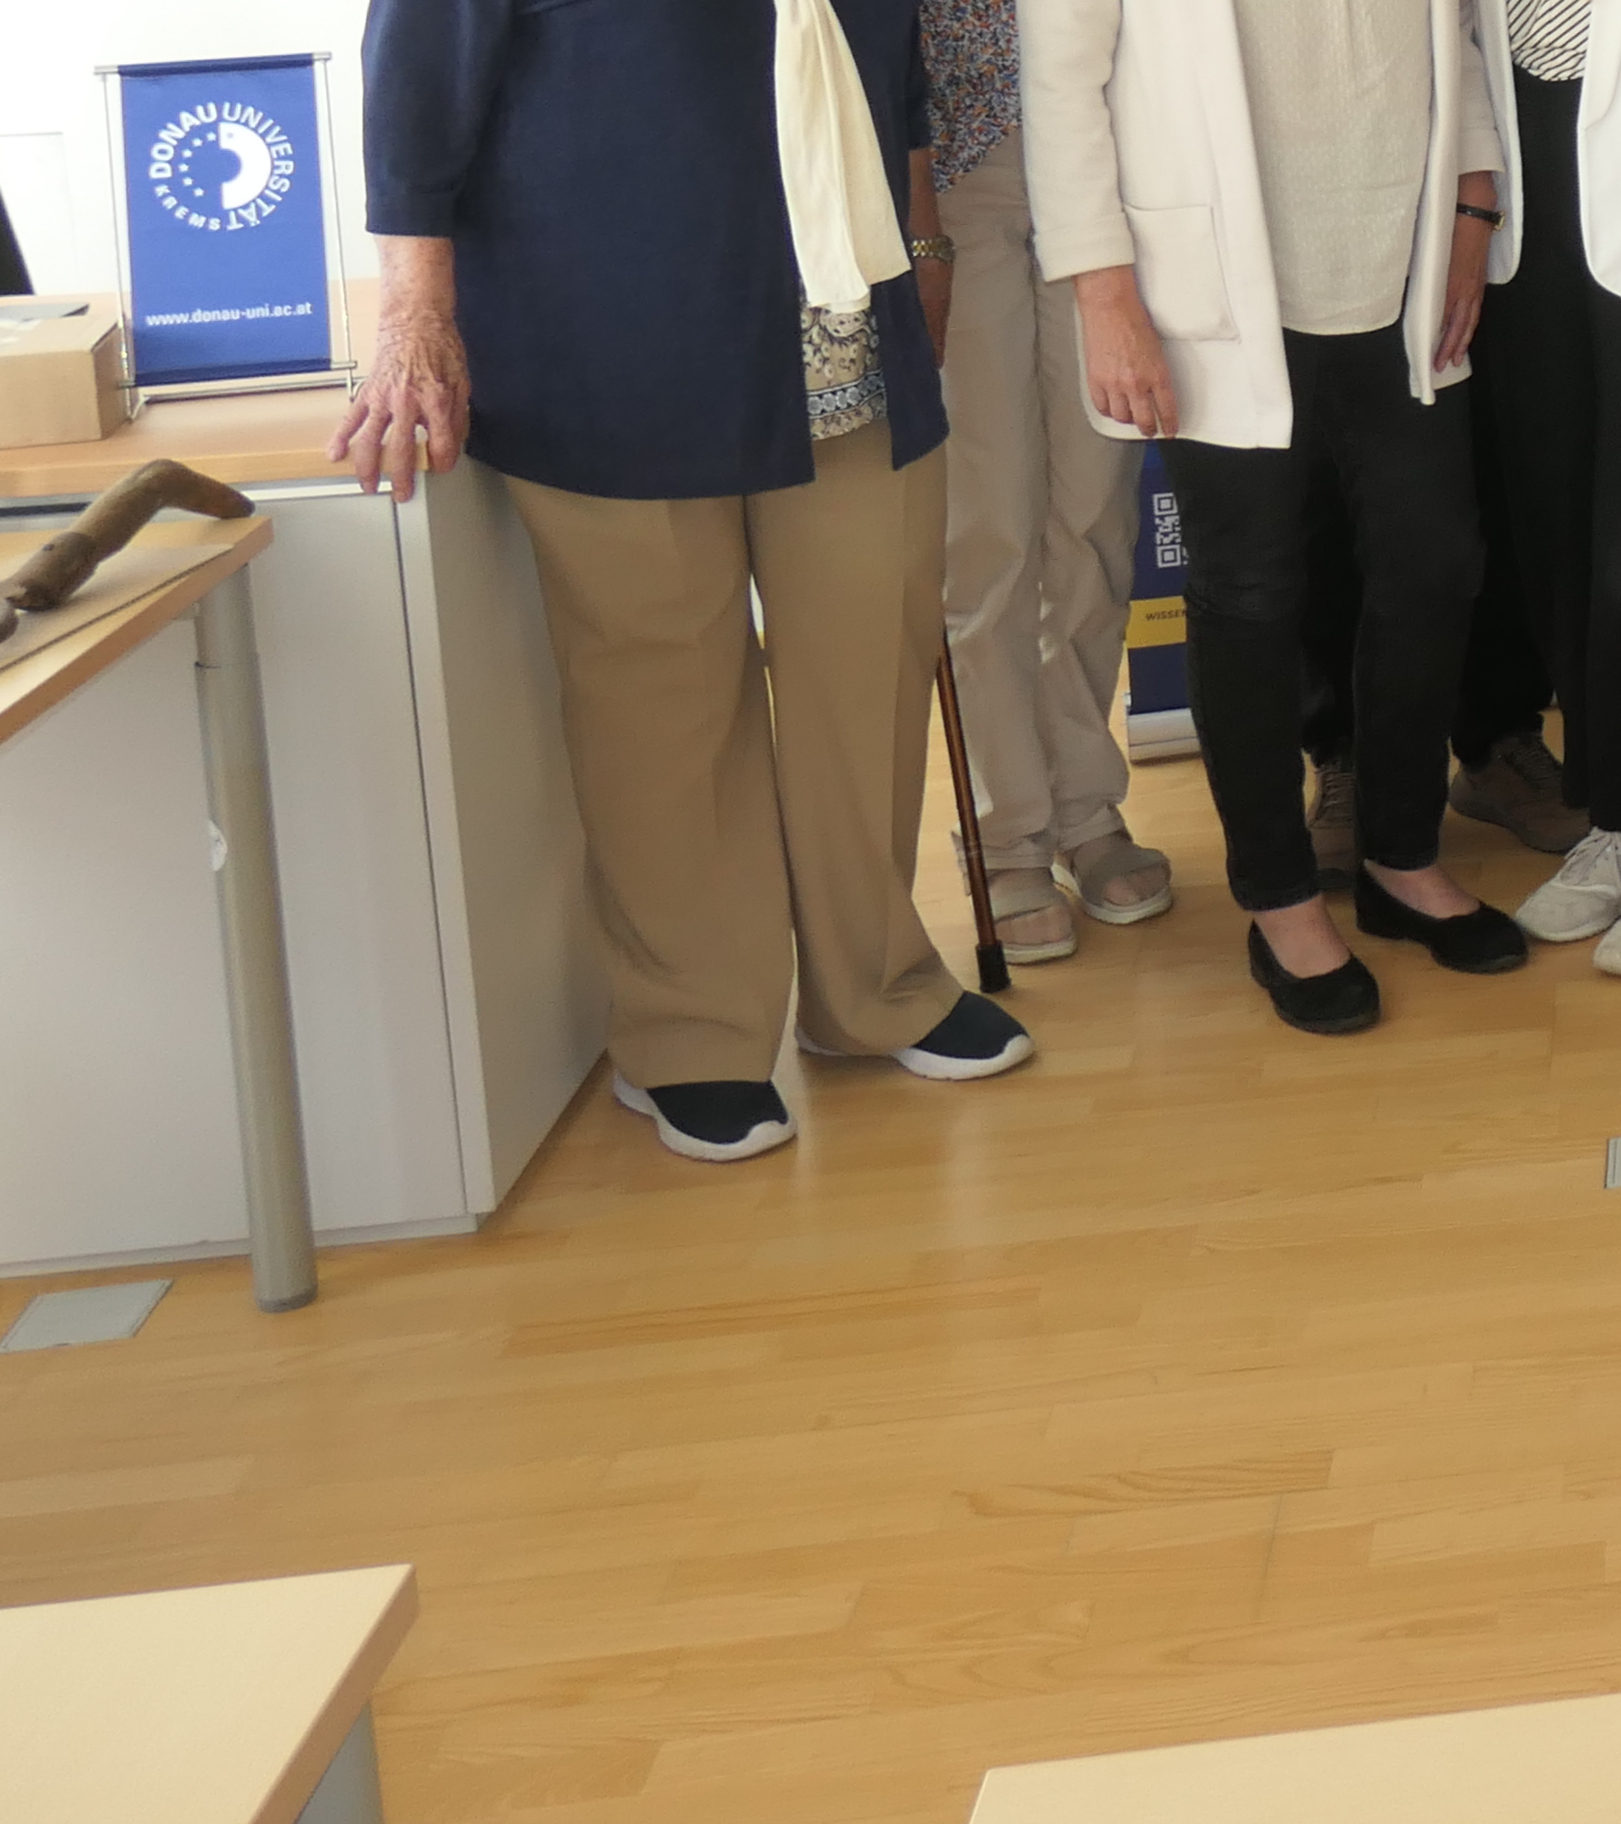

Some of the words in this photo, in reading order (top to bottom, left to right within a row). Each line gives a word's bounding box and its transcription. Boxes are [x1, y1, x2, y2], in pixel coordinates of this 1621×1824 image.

[149, 102, 219, 179] DONAU
[222, 101, 295, 231] UNIVERSITÄT
[154, 184, 221, 231] KREMS
[146, 301, 313, 327] www.donau-uni.ac.at
